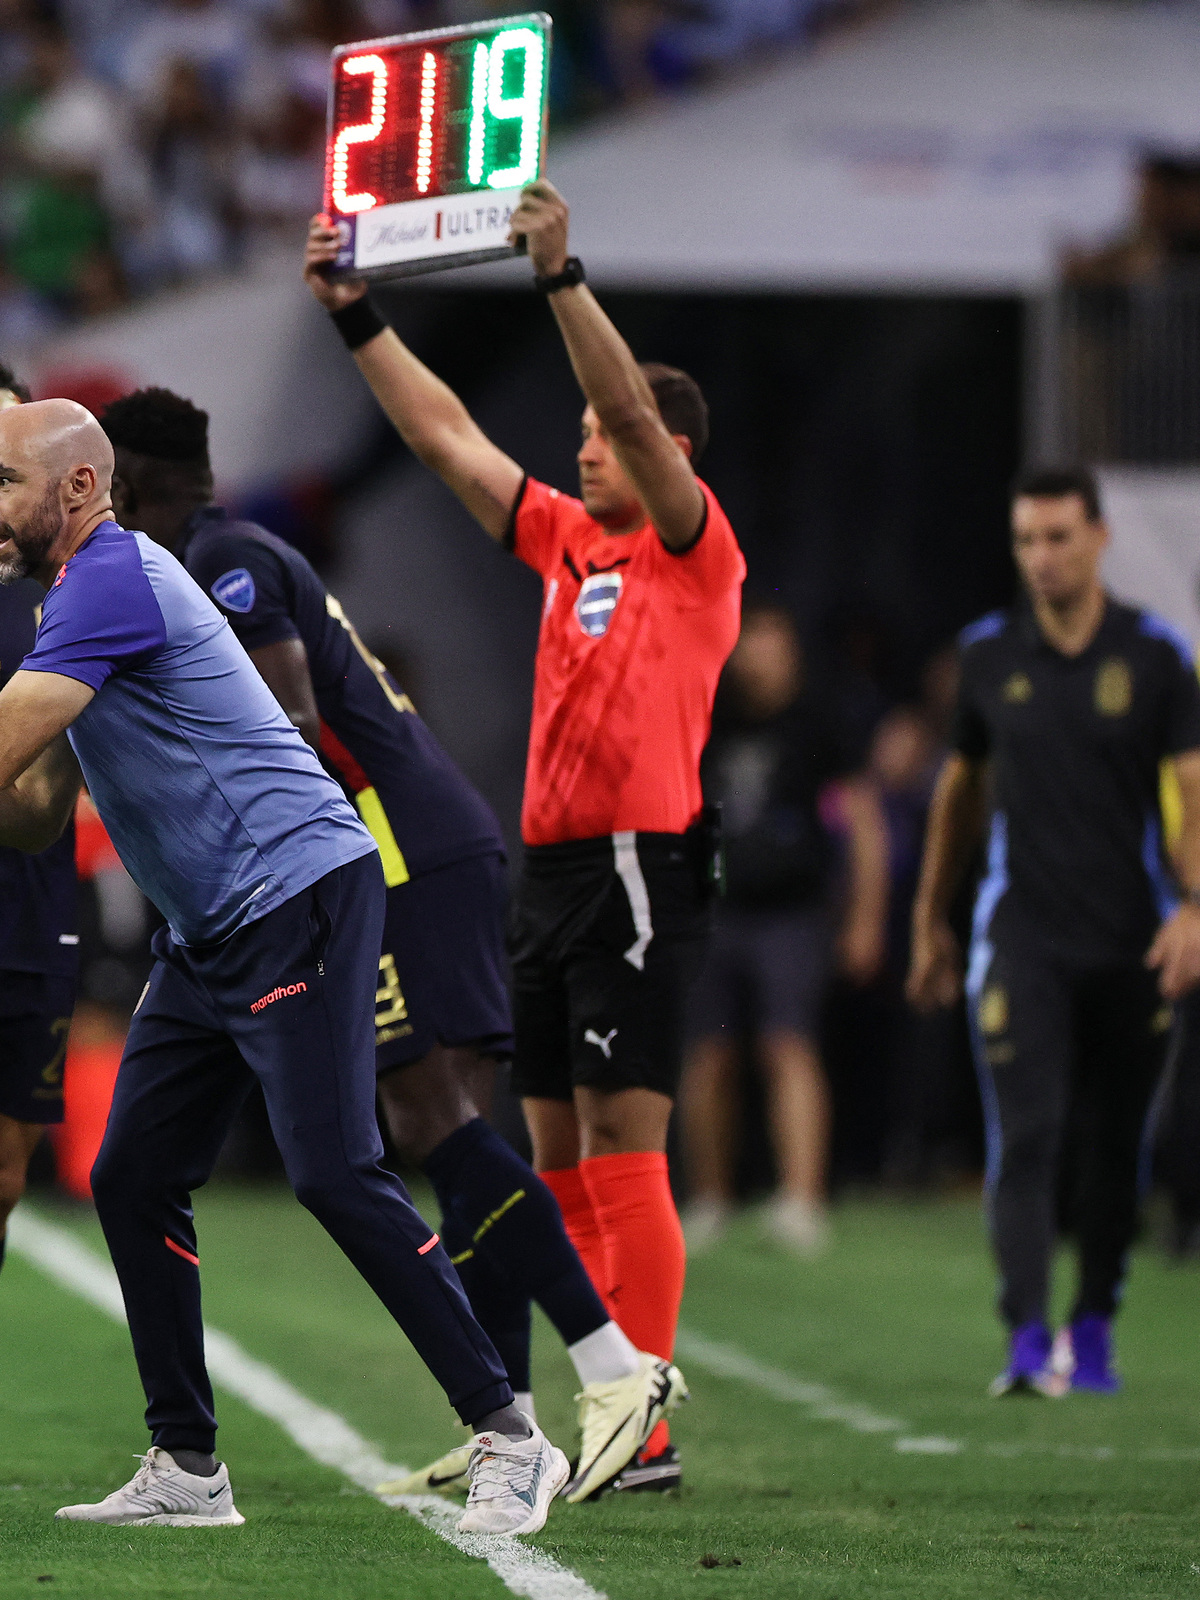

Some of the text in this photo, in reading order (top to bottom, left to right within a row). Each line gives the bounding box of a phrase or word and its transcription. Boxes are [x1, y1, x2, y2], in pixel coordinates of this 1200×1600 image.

[332, 27, 543, 213] 21 19
[250, 981, 307, 1014] marathon
